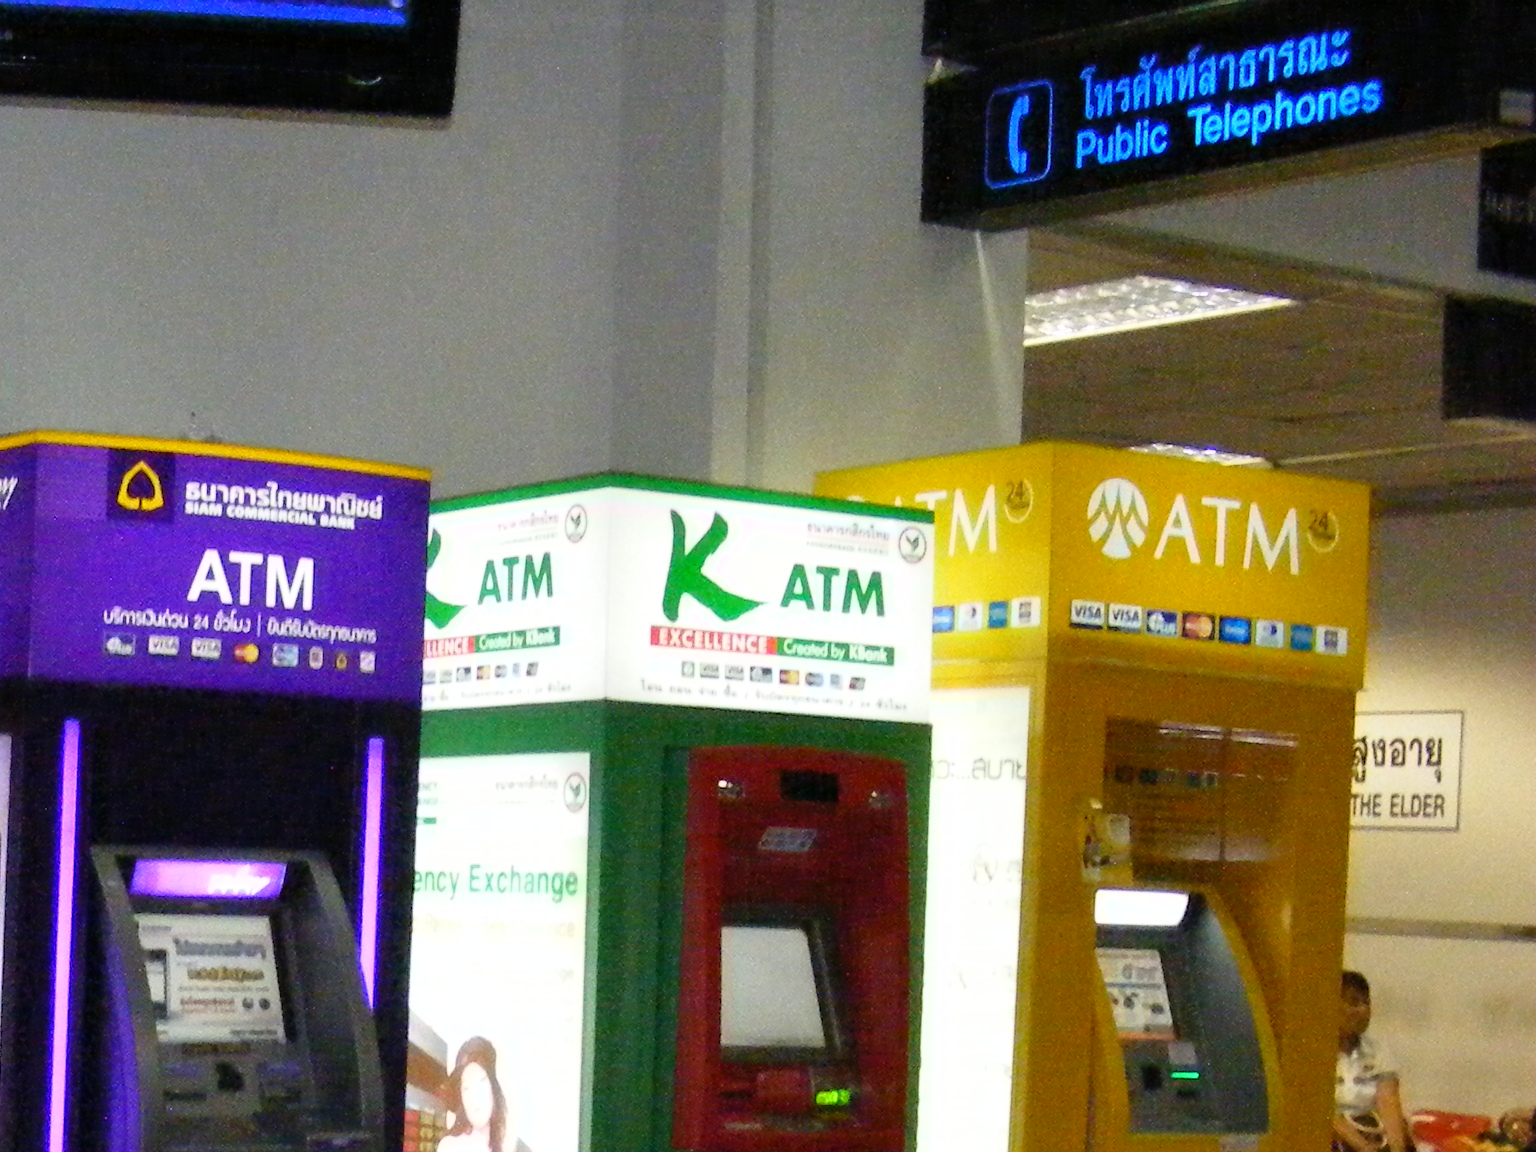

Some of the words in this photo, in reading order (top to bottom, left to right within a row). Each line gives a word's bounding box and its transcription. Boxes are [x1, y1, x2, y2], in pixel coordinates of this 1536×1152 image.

[1080, 30, 1352, 120] โทรศัพท์สาธารณะ
[1075, 122, 1170, 169] Public
[1187, 78, 1384, 145] Telephones
[185, 501, 222, 517] SIAM
[226, 504, 316, 525] COMMERCIAL
[319, 513, 356, 530] BANK
[1154, 494, 1300, 575] ATM
[187, 548, 316, 611] ATM
[477, 552, 554, 605] ATM
[662, 509, 766, 622] K
[781, 563, 886, 616] ATM
[1075, 604, 1102, 618] VISA
[1112, 608, 1140, 623] VISA
[658, 628, 768, 653] EXCELLENCE
[783, 638, 827, 658] Created
[830, 645, 846, 660] by
[848, 645, 889, 662] KBank
[1351, 794, 1382, 817] THE
[1389, 794, 1445, 818] ELDER
[469, 864, 579, 903] Exchange
